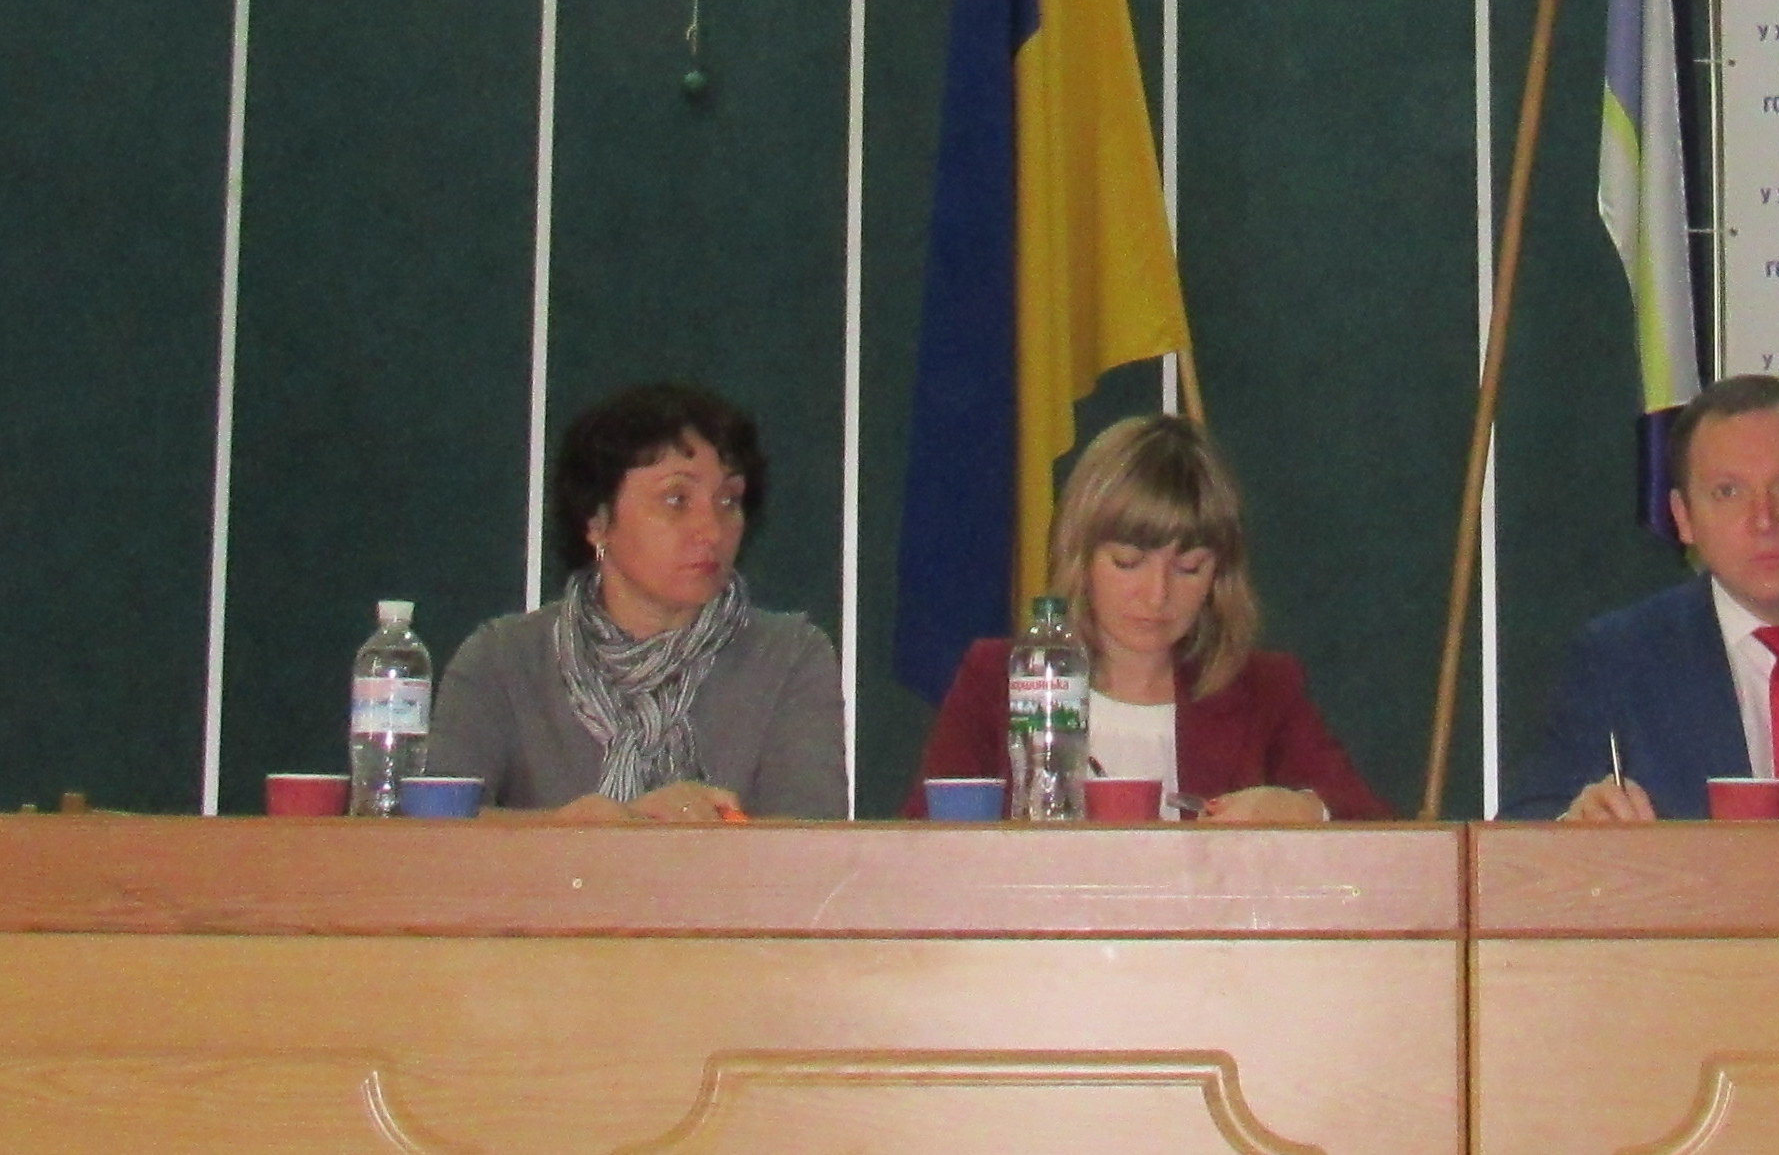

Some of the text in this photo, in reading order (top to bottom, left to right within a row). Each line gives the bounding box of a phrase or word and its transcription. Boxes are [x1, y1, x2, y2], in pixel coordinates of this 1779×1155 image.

[1757, 25, 1768, 41] У
[1760, 188, 1770, 204] У
[1762, 355, 1772, 369] У
